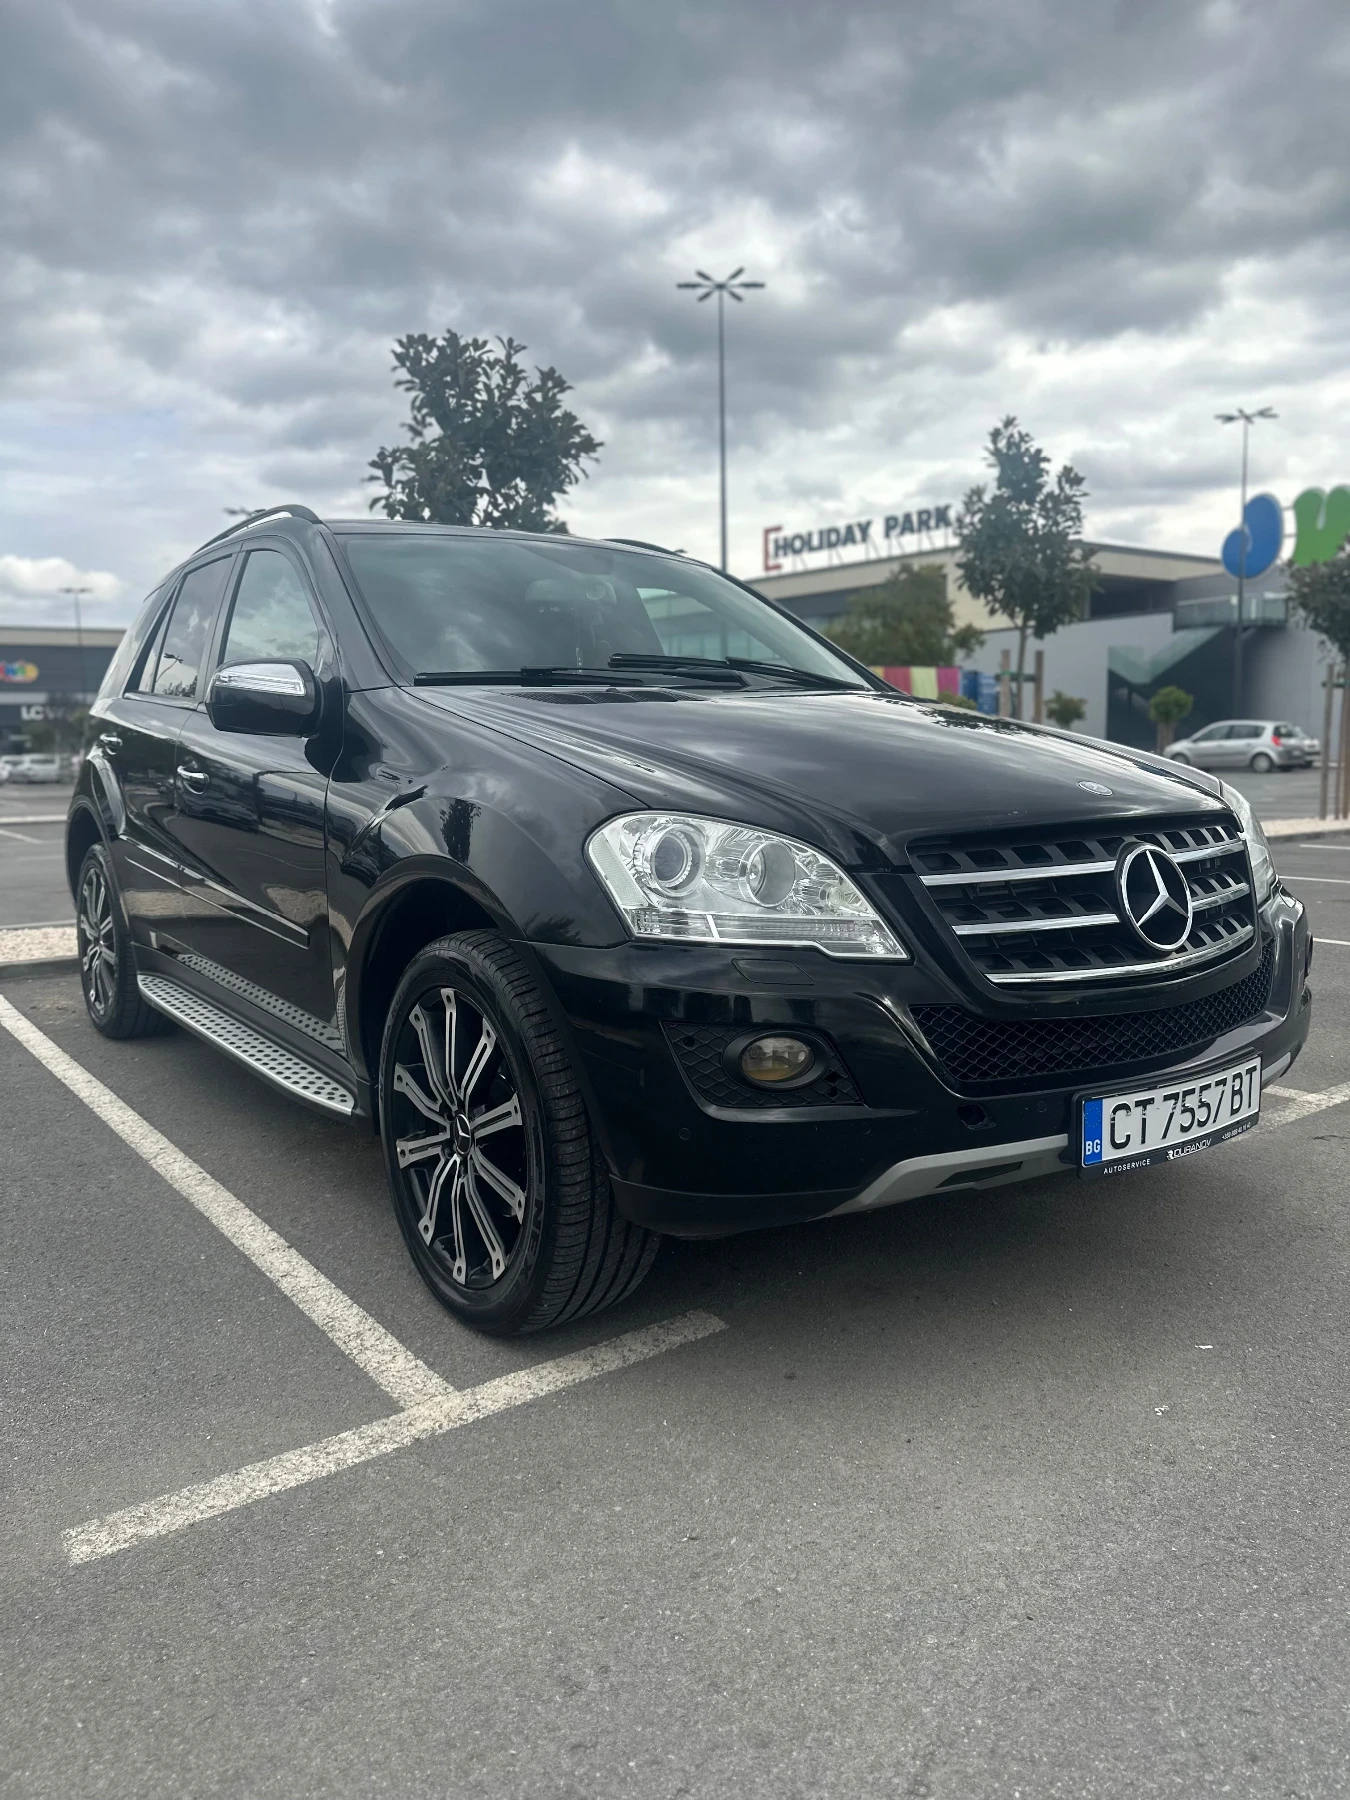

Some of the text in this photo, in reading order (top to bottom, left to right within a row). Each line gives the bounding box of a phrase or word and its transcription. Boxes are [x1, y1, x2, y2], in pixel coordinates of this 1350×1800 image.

[773, 504, 952, 558] HOLIDAY PARK
[1085, 1139, 1101, 1155] BG
[1103, 1158, 1151, 1175] AUTOSERVICE
